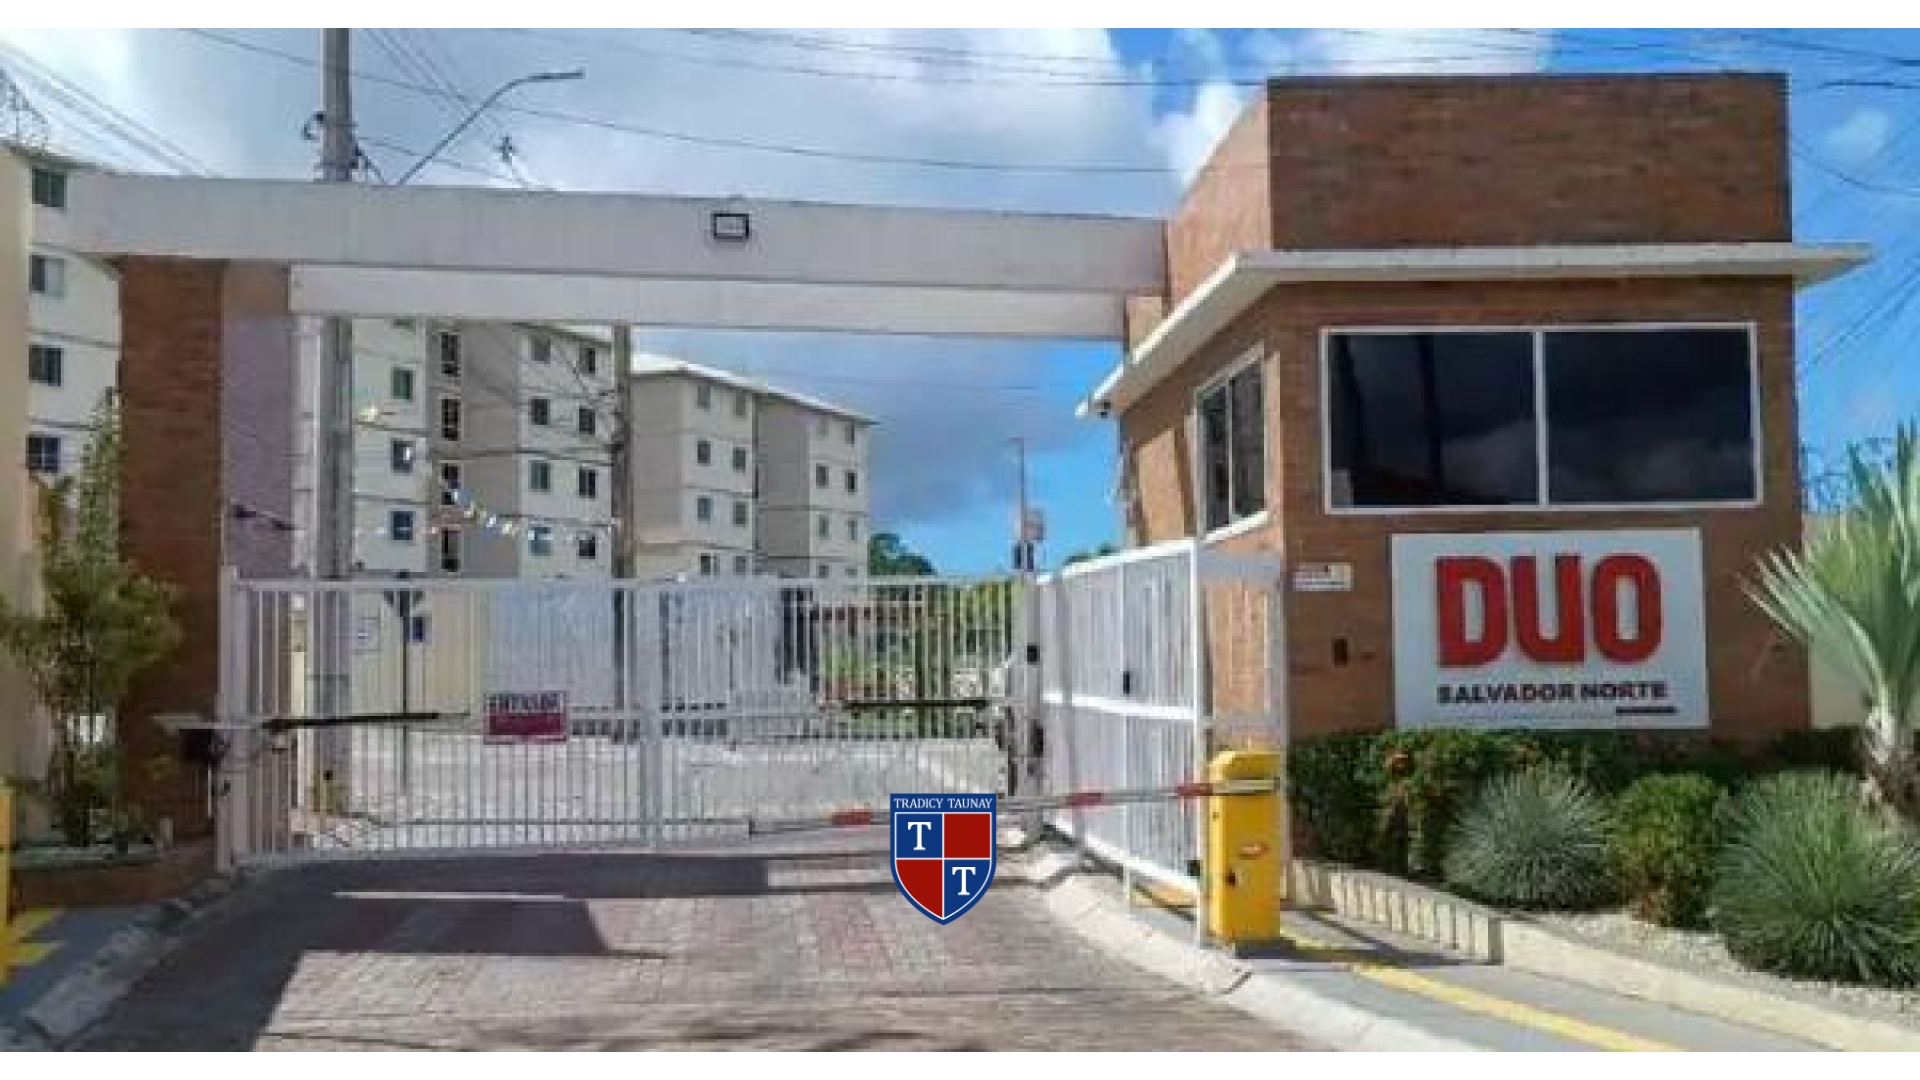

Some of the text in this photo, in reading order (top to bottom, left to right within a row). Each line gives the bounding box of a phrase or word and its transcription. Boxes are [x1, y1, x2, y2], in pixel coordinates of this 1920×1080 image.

[1435, 552, 1663, 668] DUO
[1436, 680, 1668, 704] SALVADOR NORTE
